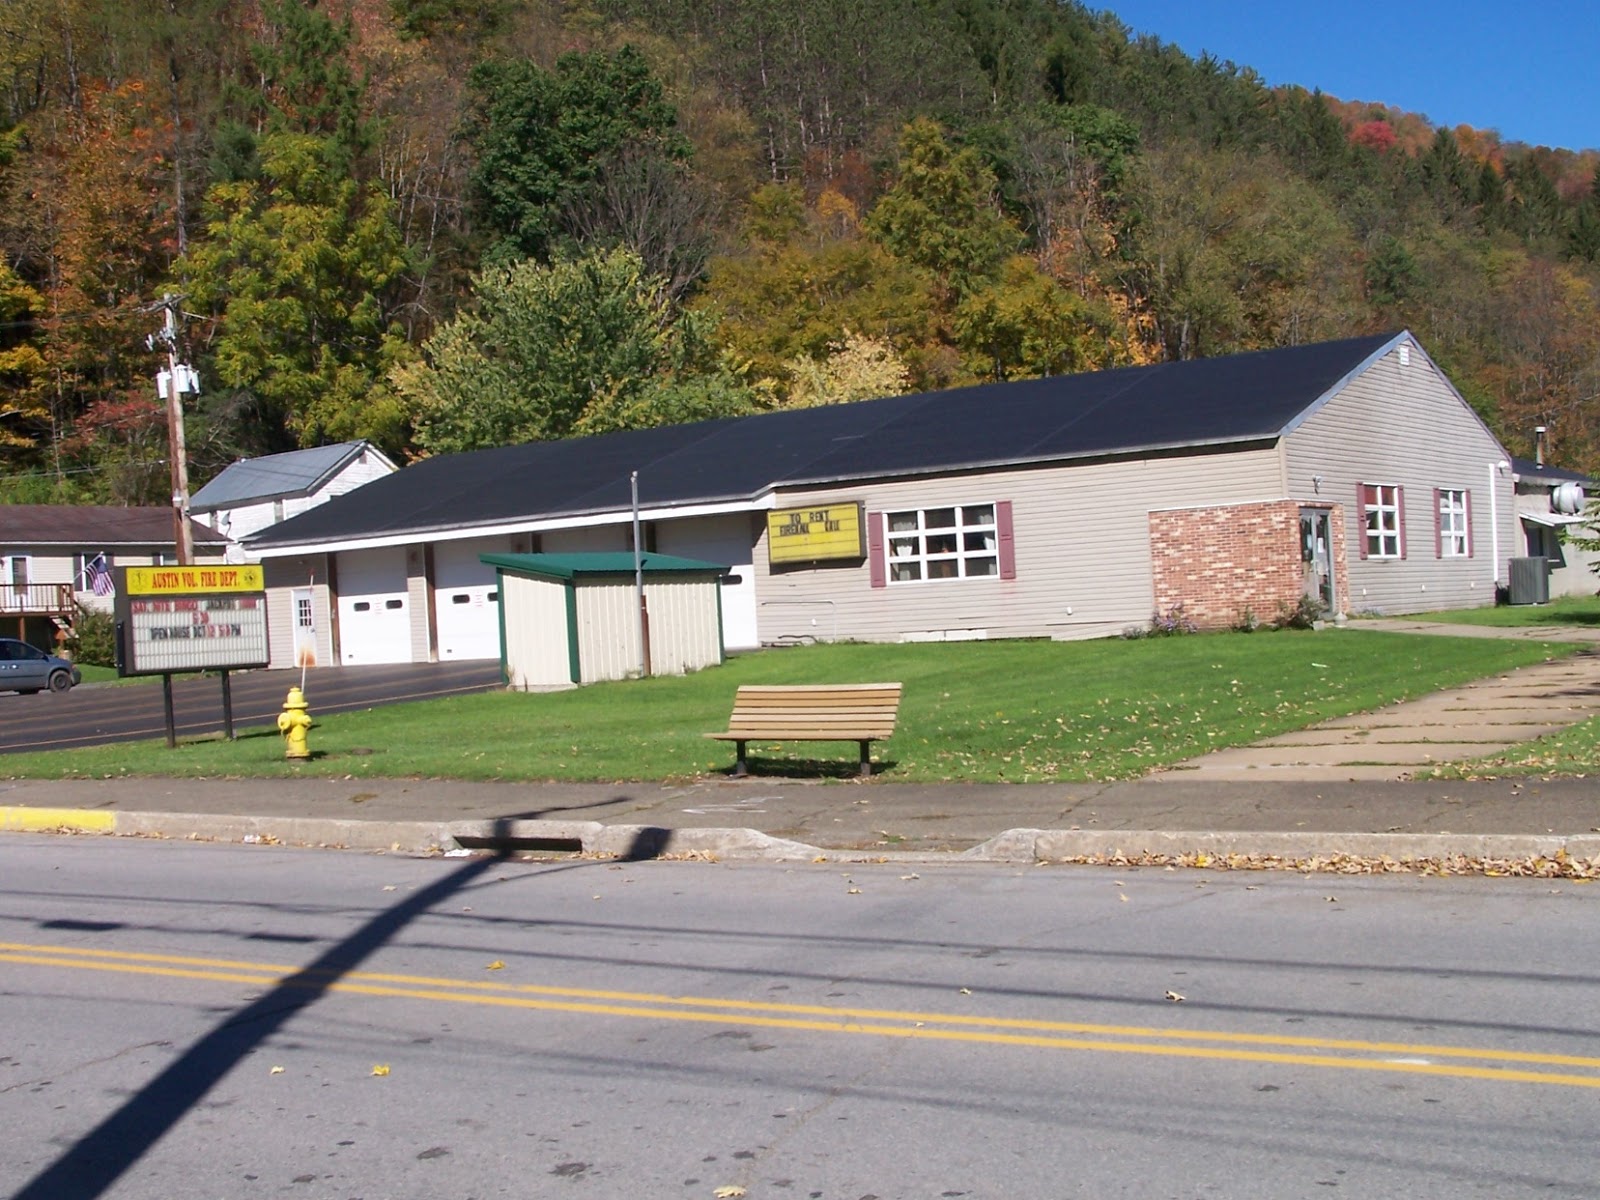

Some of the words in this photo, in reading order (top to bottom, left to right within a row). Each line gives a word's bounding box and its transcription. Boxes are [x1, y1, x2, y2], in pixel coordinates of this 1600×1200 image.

[790, 513, 801, 524] TO
[809, 510, 829, 522] RENT
[152, 571, 179, 588] AUSTIN
[182, 571, 198, 587] VOL.
[201, 571, 217, 587] FIRE
[220, 571, 240, 587] DEPT.
[151, 627, 168, 640] OPEN
[193, 625, 206, 638] OCT
